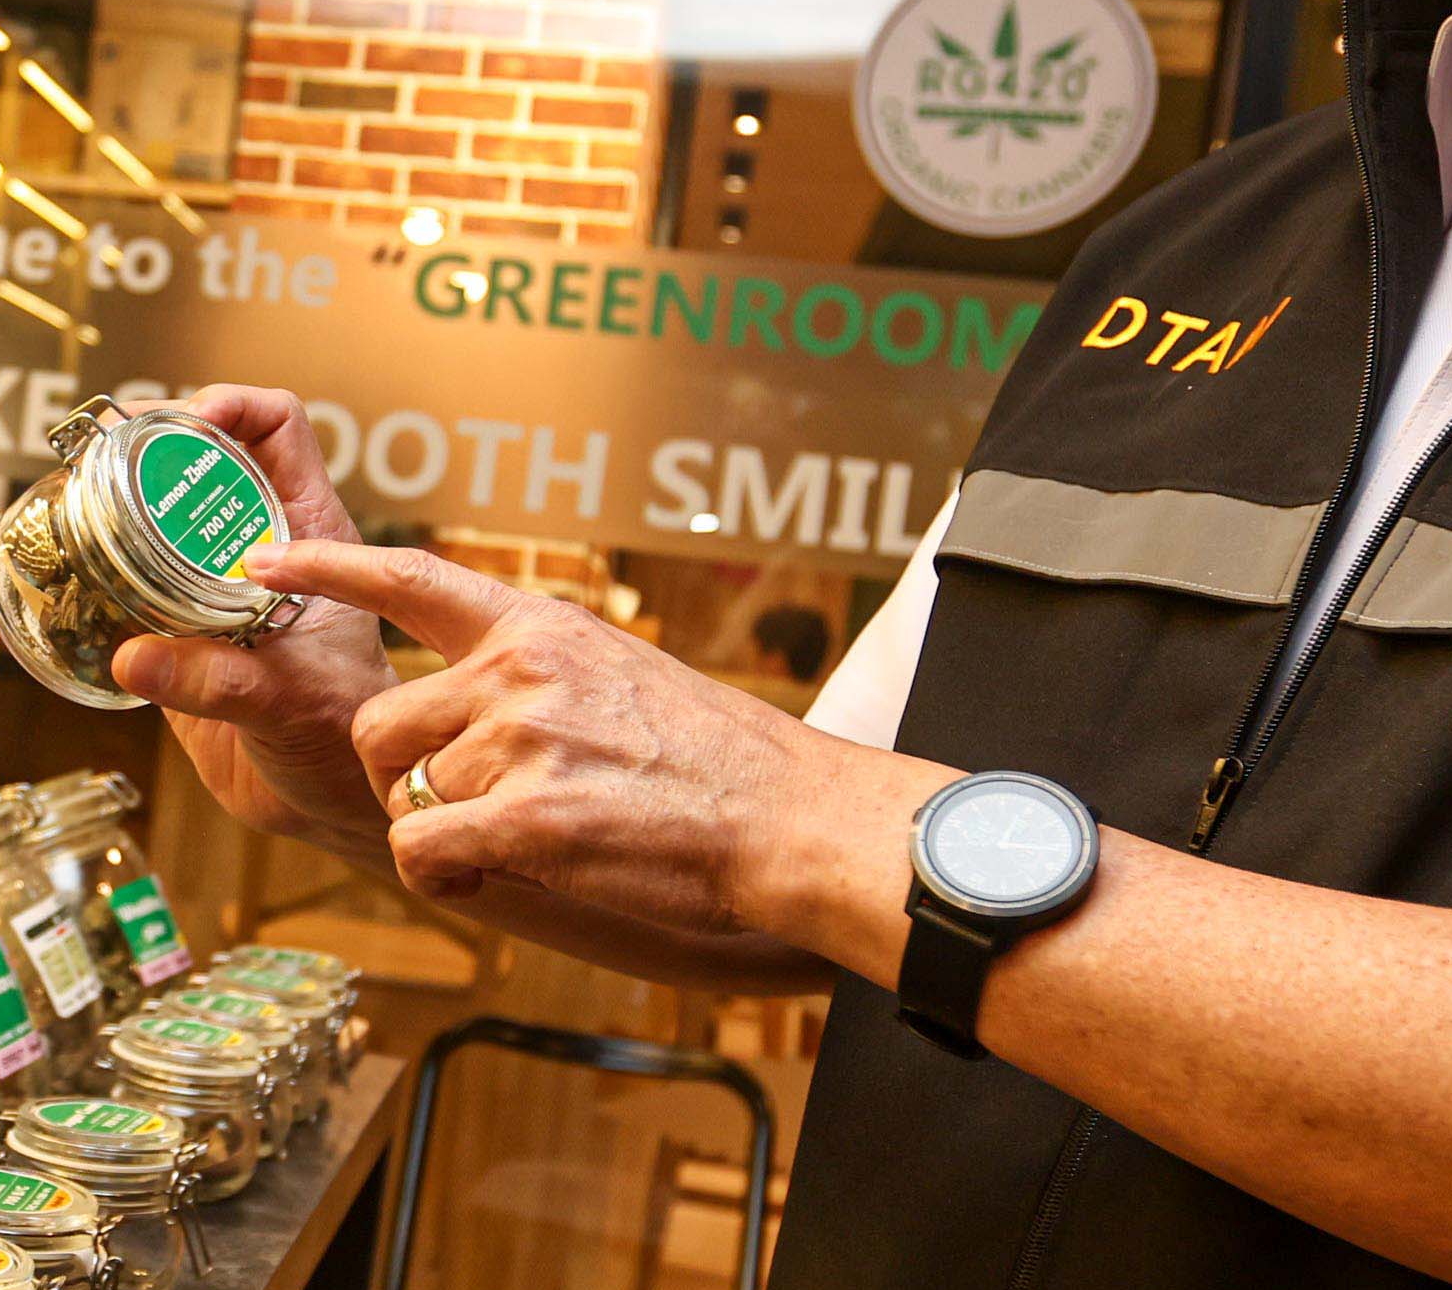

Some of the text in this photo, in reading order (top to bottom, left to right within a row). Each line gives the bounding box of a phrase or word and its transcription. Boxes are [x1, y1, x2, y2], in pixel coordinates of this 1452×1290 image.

[86, 224, 173, 294] to
[198, 227, 340, 308] the
[148, 479, 191, 520] Lemon
[198, 495, 245, 544] 700 B/G
[643, 437, 962, 559] SMIL
[212, 550, 231, 570] THC
